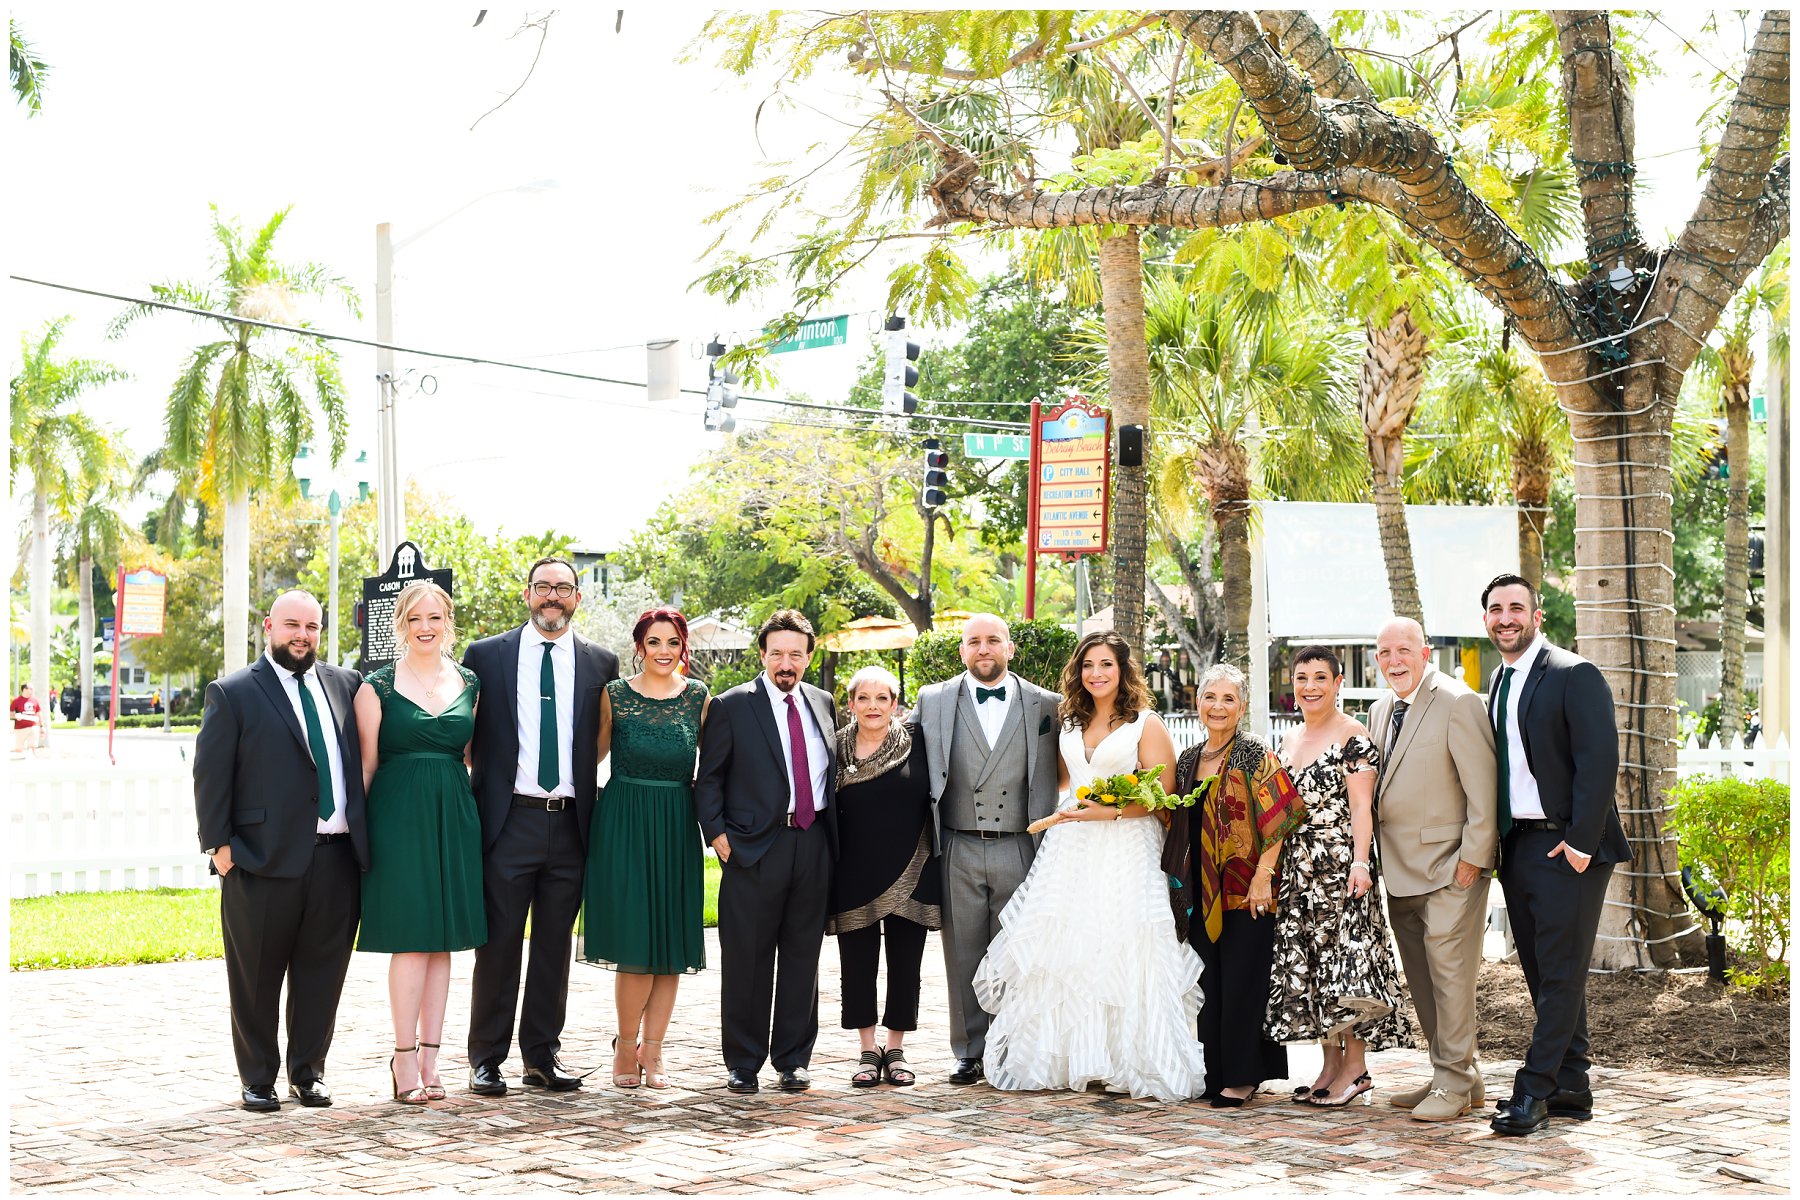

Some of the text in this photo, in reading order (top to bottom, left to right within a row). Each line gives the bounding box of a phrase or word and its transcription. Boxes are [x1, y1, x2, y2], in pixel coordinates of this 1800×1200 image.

[976, 434, 985, 450] N
[1012, 437, 1025, 452] St
[1043, 437, 1103, 458] Delray Beach
[1060, 466, 1090, 477] CITY HALL
[1044, 489, 1093, 499] RECREATION CENTER
[1044, 511, 1088, 520] ATLANTIC AVENUE
[379, 581, 400, 592] CASON
